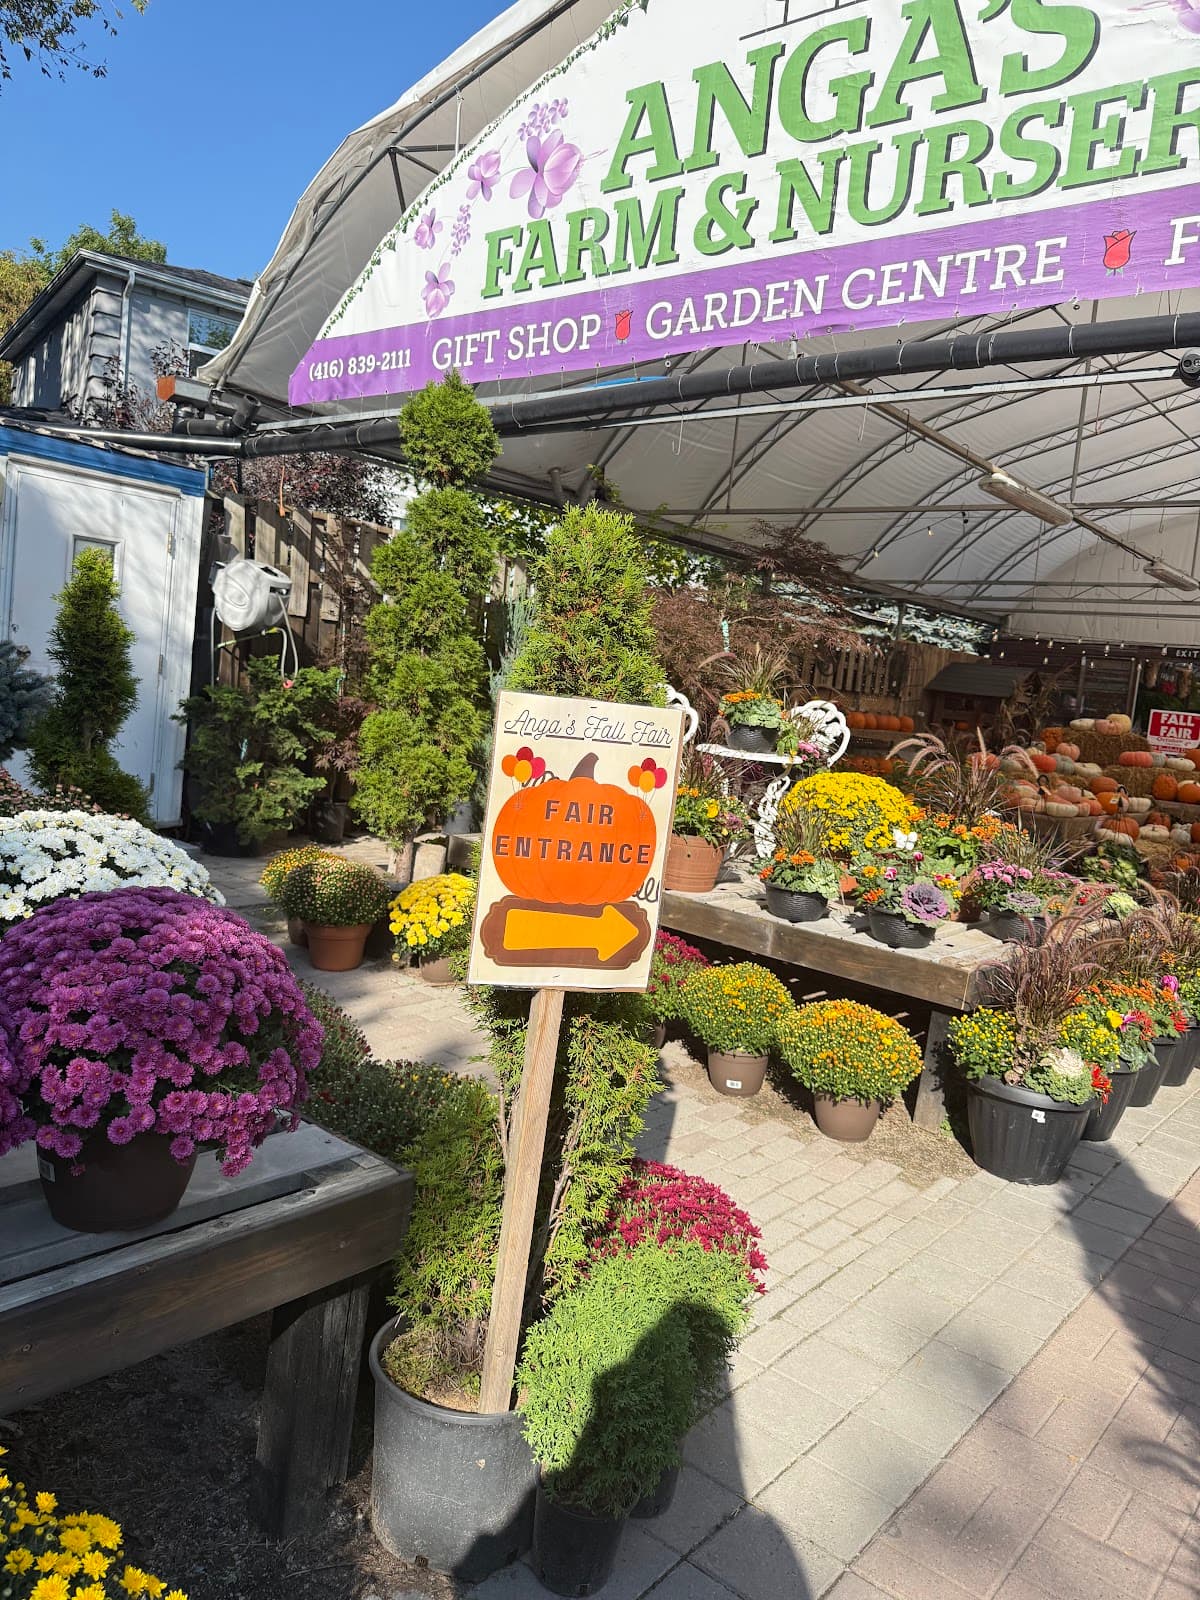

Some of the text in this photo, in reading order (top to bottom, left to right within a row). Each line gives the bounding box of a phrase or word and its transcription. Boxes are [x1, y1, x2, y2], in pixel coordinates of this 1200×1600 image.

[481, 186, 686, 298] FARM
[694, 171, 759, 257] &
[645, 236, 1069, 340] GARDEN CENTRE
[431, 313, 601, 370] GIFT SHOP
[309, 348, 411, 381] (416) 839-2111
[1175, 649, 1199, 658] EXIT
[504, 709, 673, 744] Anga's Fall Fair
[1160, 712, 1195, 727] FALL
[1160, 725, 1192, 739] FAIR
[545, 800, 615, 825] FAIR
[495, 834, 651, 865] ENTRANCE
